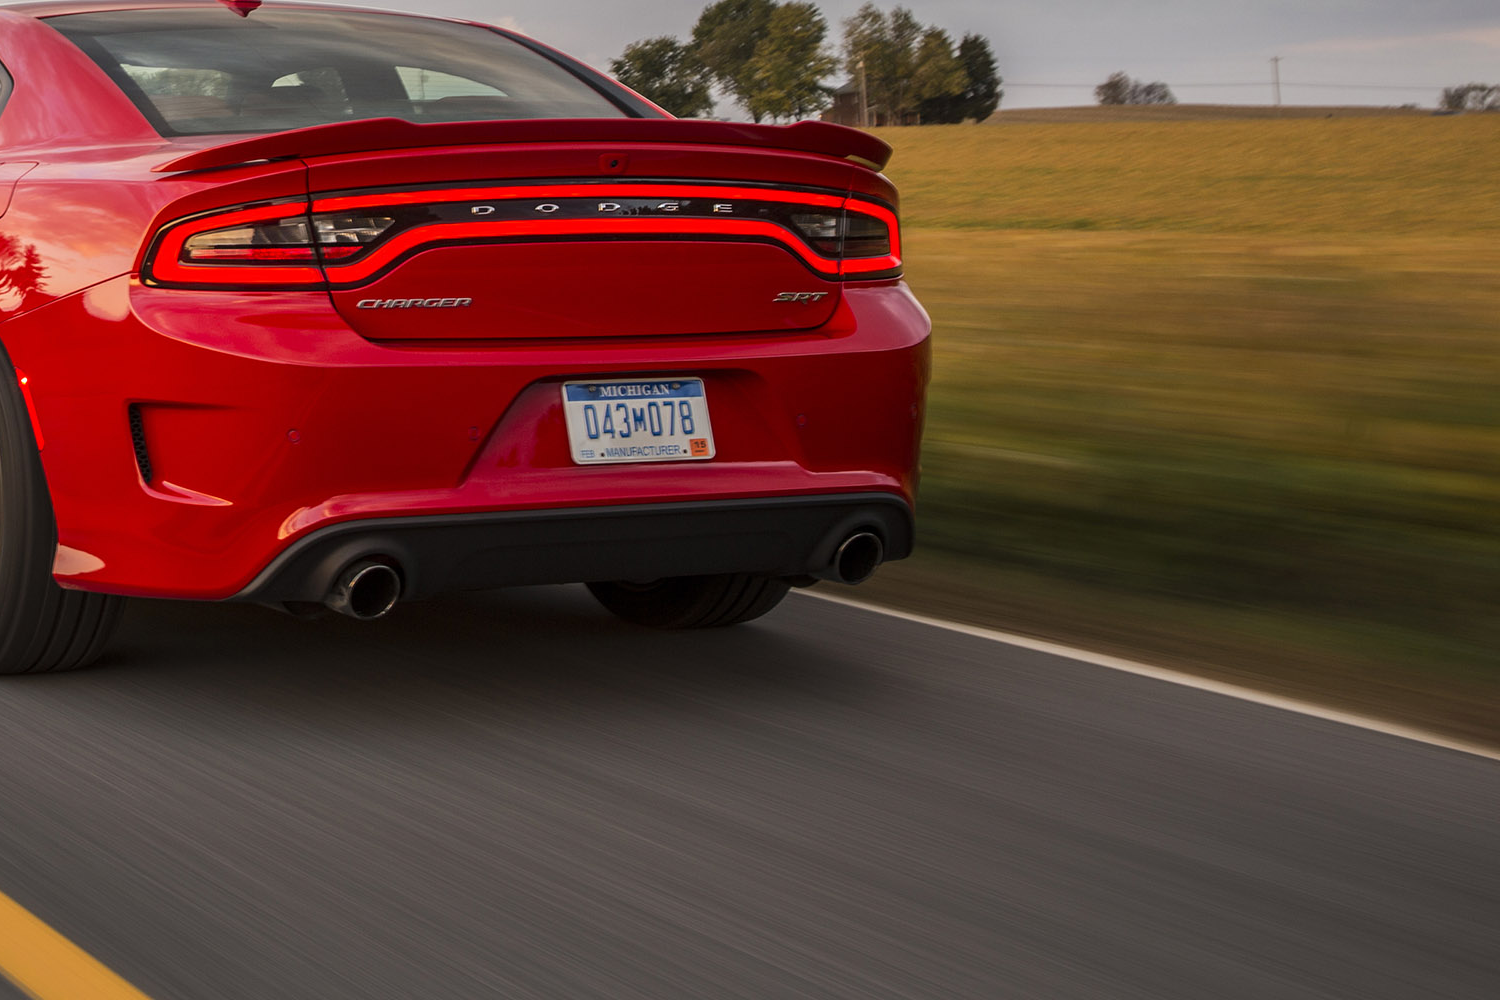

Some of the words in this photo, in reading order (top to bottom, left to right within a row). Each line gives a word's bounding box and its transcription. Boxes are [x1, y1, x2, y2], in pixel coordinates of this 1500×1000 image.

[471, 202, 733, 215] DODGE
[356, 297, 472, 309] CHARGER
[772, 291, 829, 305] SRT
[600, 384, 670, 397] MICHIGAN
[584, 400, 695, 439] 043M078
[693, 440, 706, 448] 15
[605, 445, 681, 457] MANUFACTURER
